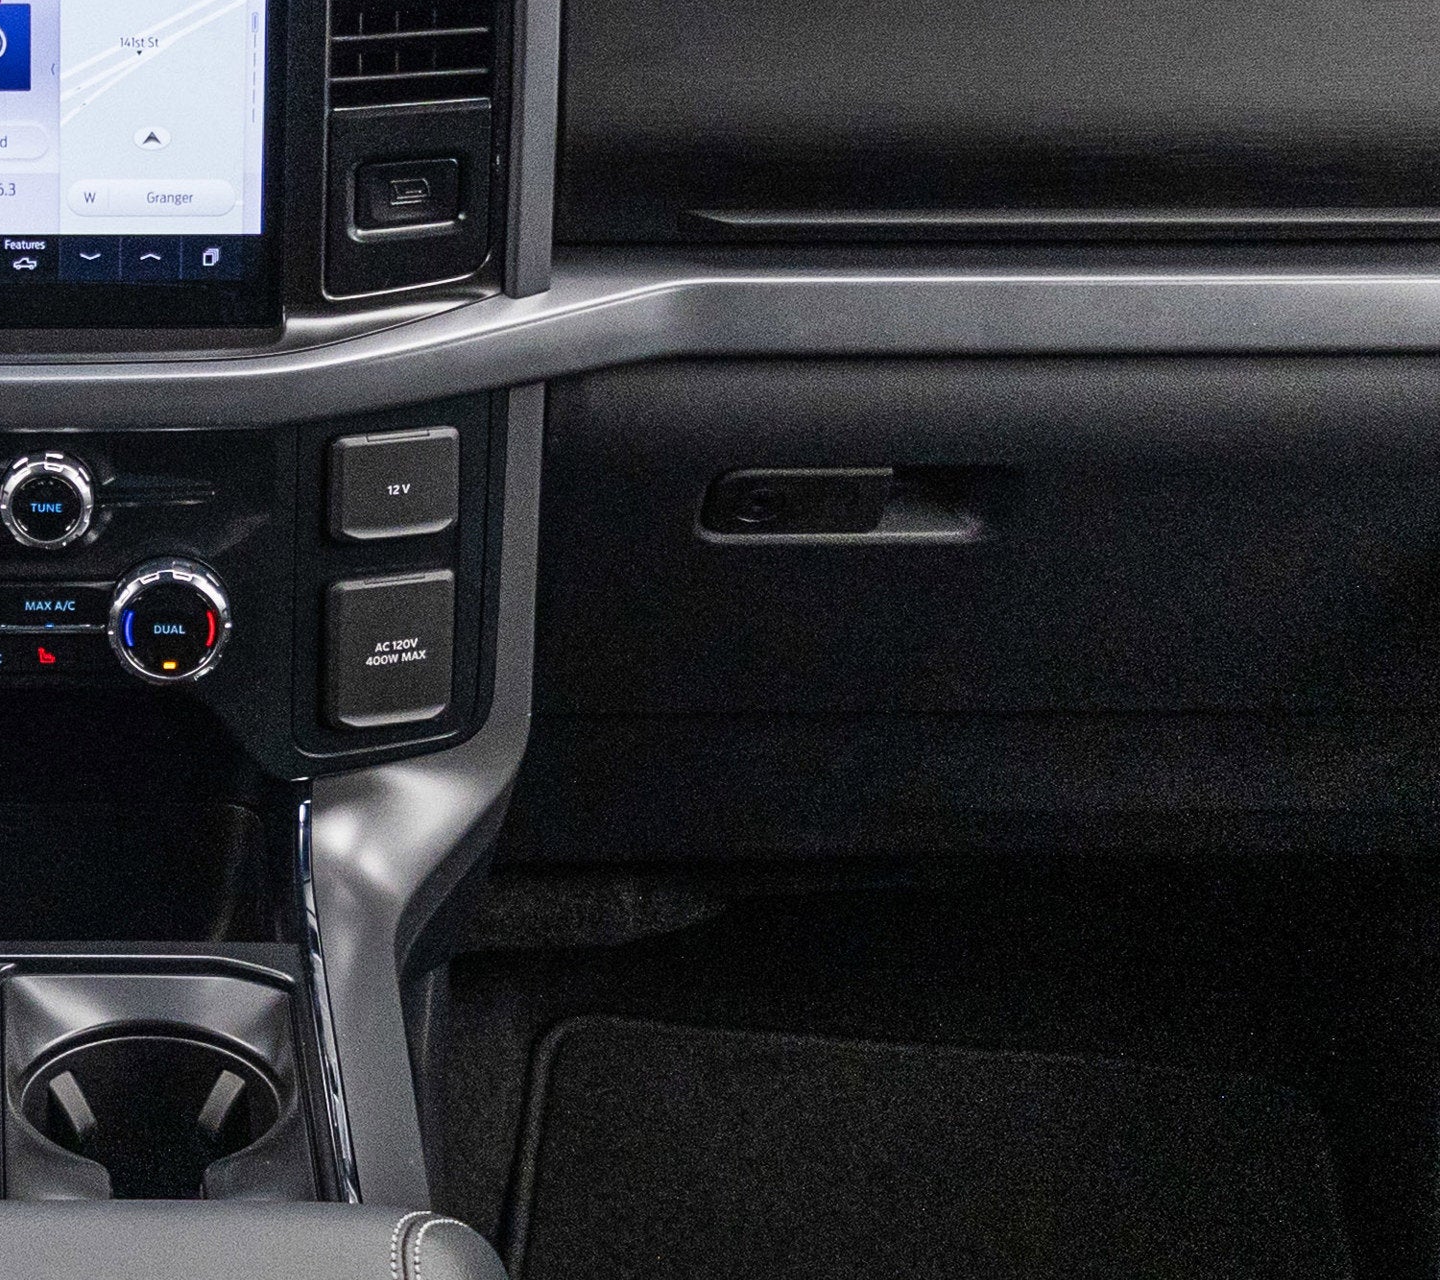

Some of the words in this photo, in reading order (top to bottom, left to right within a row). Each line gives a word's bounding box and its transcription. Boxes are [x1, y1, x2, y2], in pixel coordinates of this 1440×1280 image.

[119, 37, 145, 48] 141st
[148, 36, 159, 48] St
[83, 191, 96, 204] W
[146, 191, 194, 207] Granger
[4, 239, 46, 251] Features
[387, 484, 400, 496] 12
[401, 483, 411, 494] V
[31, 503, 63, 513] TUNE
[25, 600, 51, 612] MAX
[54, 599, 76, 613] A/C
[153, 624, 185, 635] DUAL
[375, 641, 390, 653] AC
[392, 637, 418, 651] 120V
[366, 652, 399, 666] 400W
[401, 649, 427, 663] MAX
